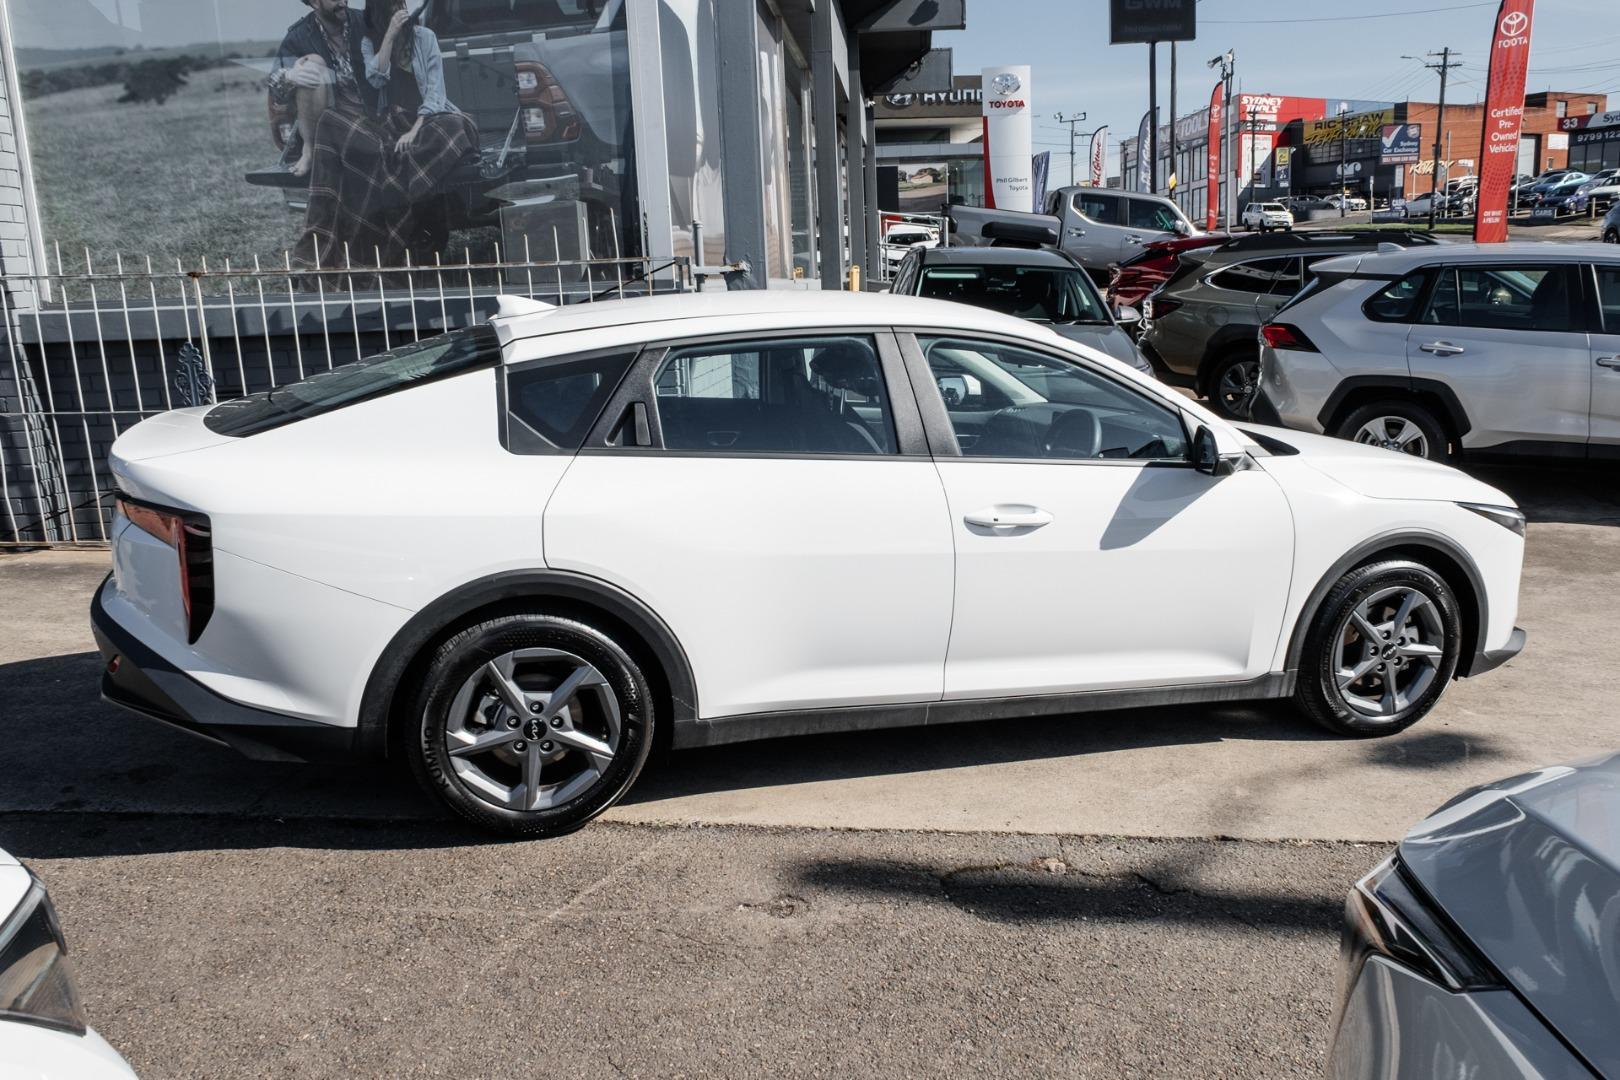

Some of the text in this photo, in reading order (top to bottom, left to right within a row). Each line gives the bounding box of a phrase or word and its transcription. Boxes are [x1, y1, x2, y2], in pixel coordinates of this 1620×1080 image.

[1498, 36, 1528, 49] TOOTA
[989, 99, 1025, 108] TOYOTA
[1241, 96, 1284, 106] SYDNEY
[1314, 120, 1337, 131] RIC
[1563, 118, 1578, 129] 33
[1491, 130, 1517, 142] Owned
[1577, 132, 1602, 142] 9799
[1009, 184, 1028, 192] Toyota
